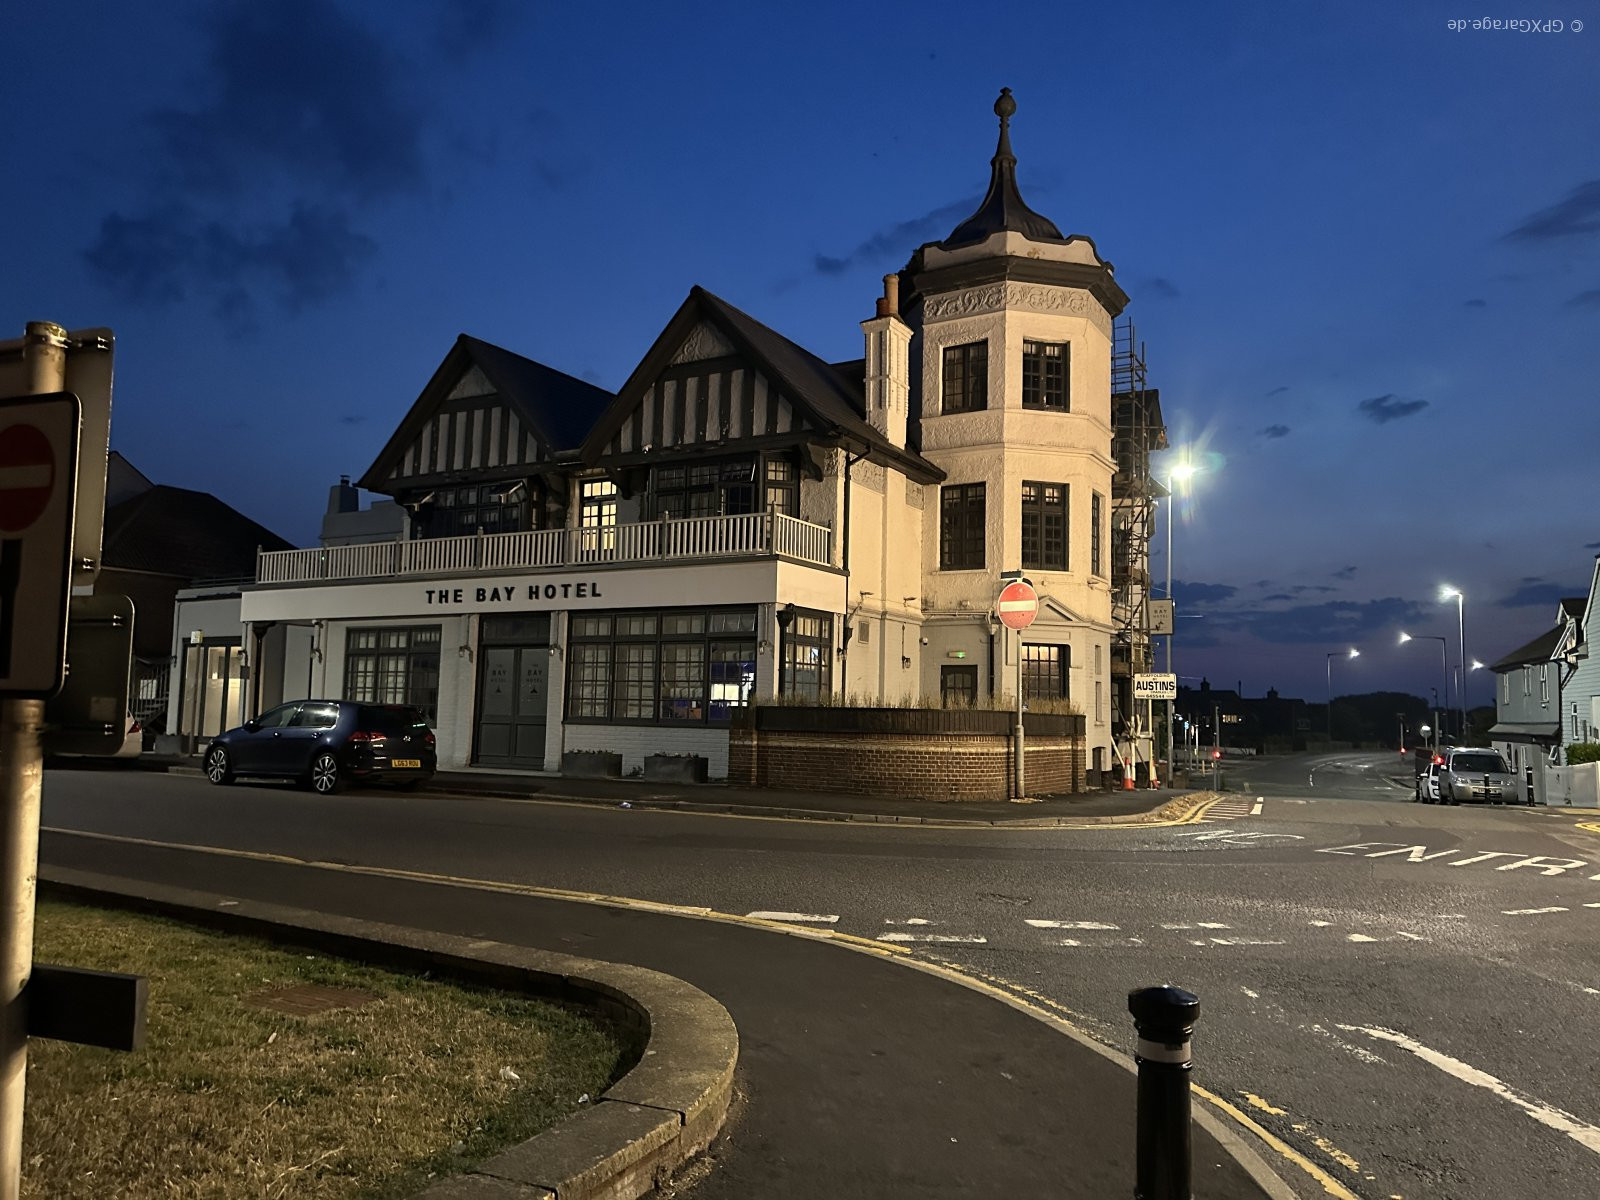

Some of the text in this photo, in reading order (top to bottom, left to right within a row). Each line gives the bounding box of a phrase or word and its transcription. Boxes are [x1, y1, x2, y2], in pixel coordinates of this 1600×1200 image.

[425, 582, 603, 604] THE BAY HOTEL
[1136, 681, 1175, 691] AUSTINS
